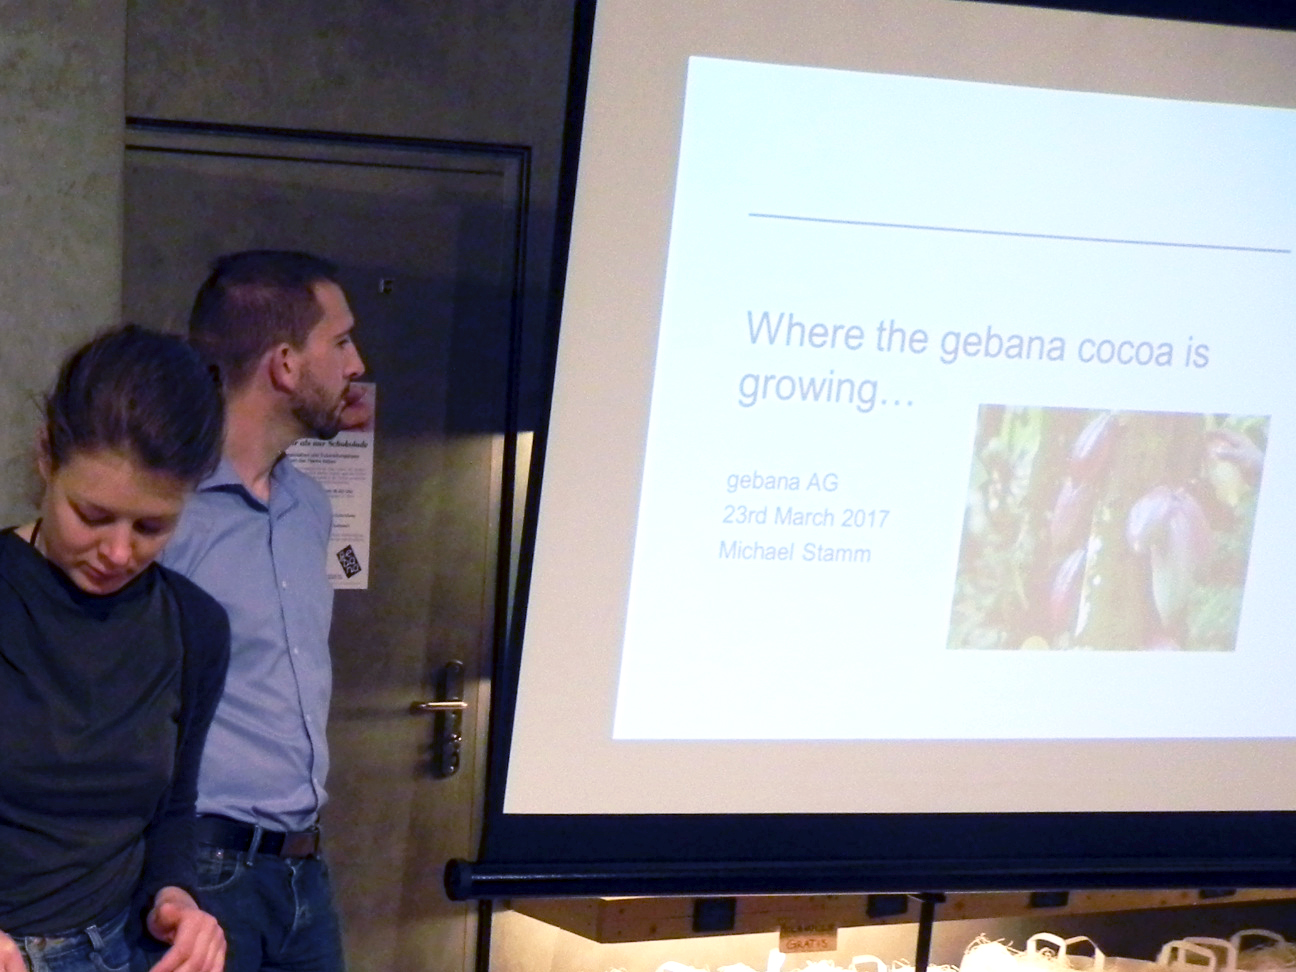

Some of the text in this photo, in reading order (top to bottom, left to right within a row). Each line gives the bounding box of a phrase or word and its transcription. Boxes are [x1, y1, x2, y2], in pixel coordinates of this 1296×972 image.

[746, 309, 1210, 368] Where the gebana cocoa is
[726, 470, 839, 494] gebana AG
[722, 504, 890, 528] 23rd March 2017
[718, 540, 871, 563] Michael Stamm
